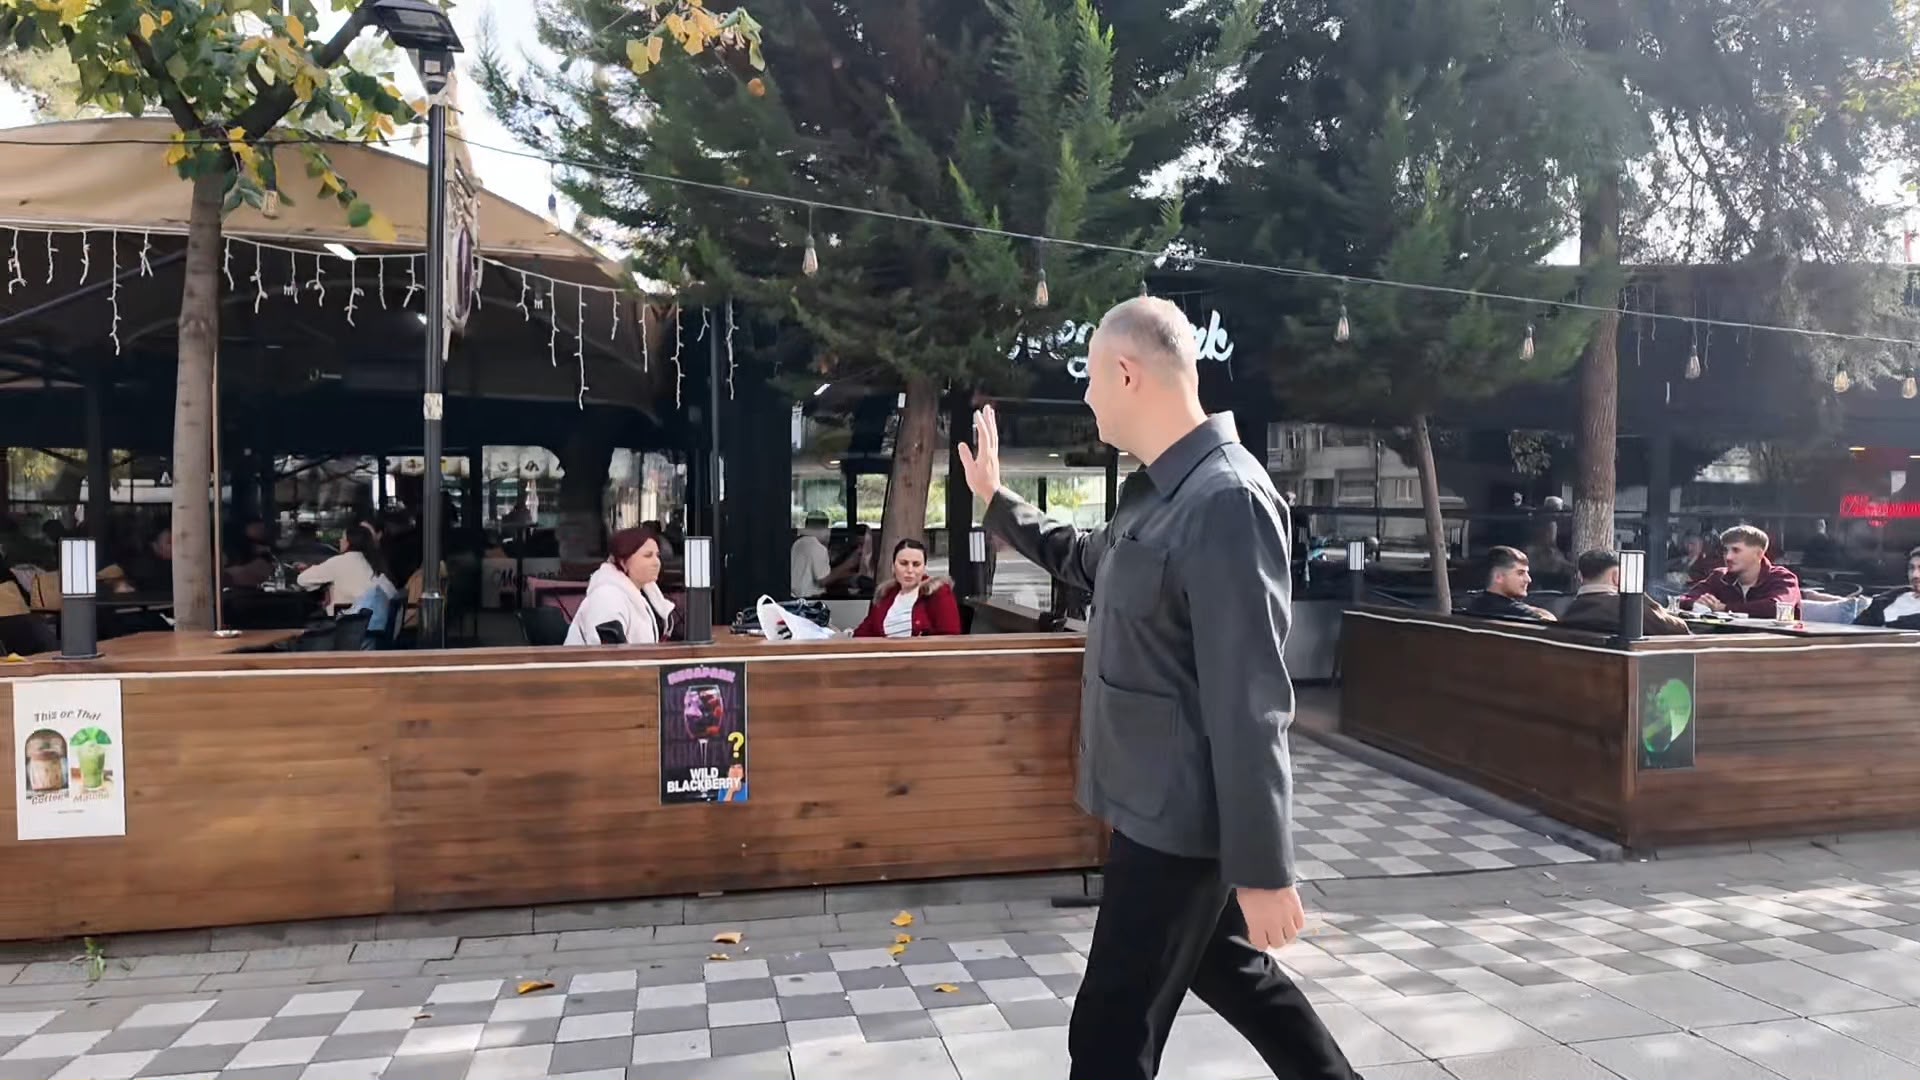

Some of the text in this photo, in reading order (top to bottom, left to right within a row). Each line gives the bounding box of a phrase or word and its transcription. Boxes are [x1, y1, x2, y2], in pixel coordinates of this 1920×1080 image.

[34, 710, 57, 722] This
[60, 710, 74, 719] or
[690, 767, 719, 780] WILD
[667, 777, 741, 793] BLACKBERRY
